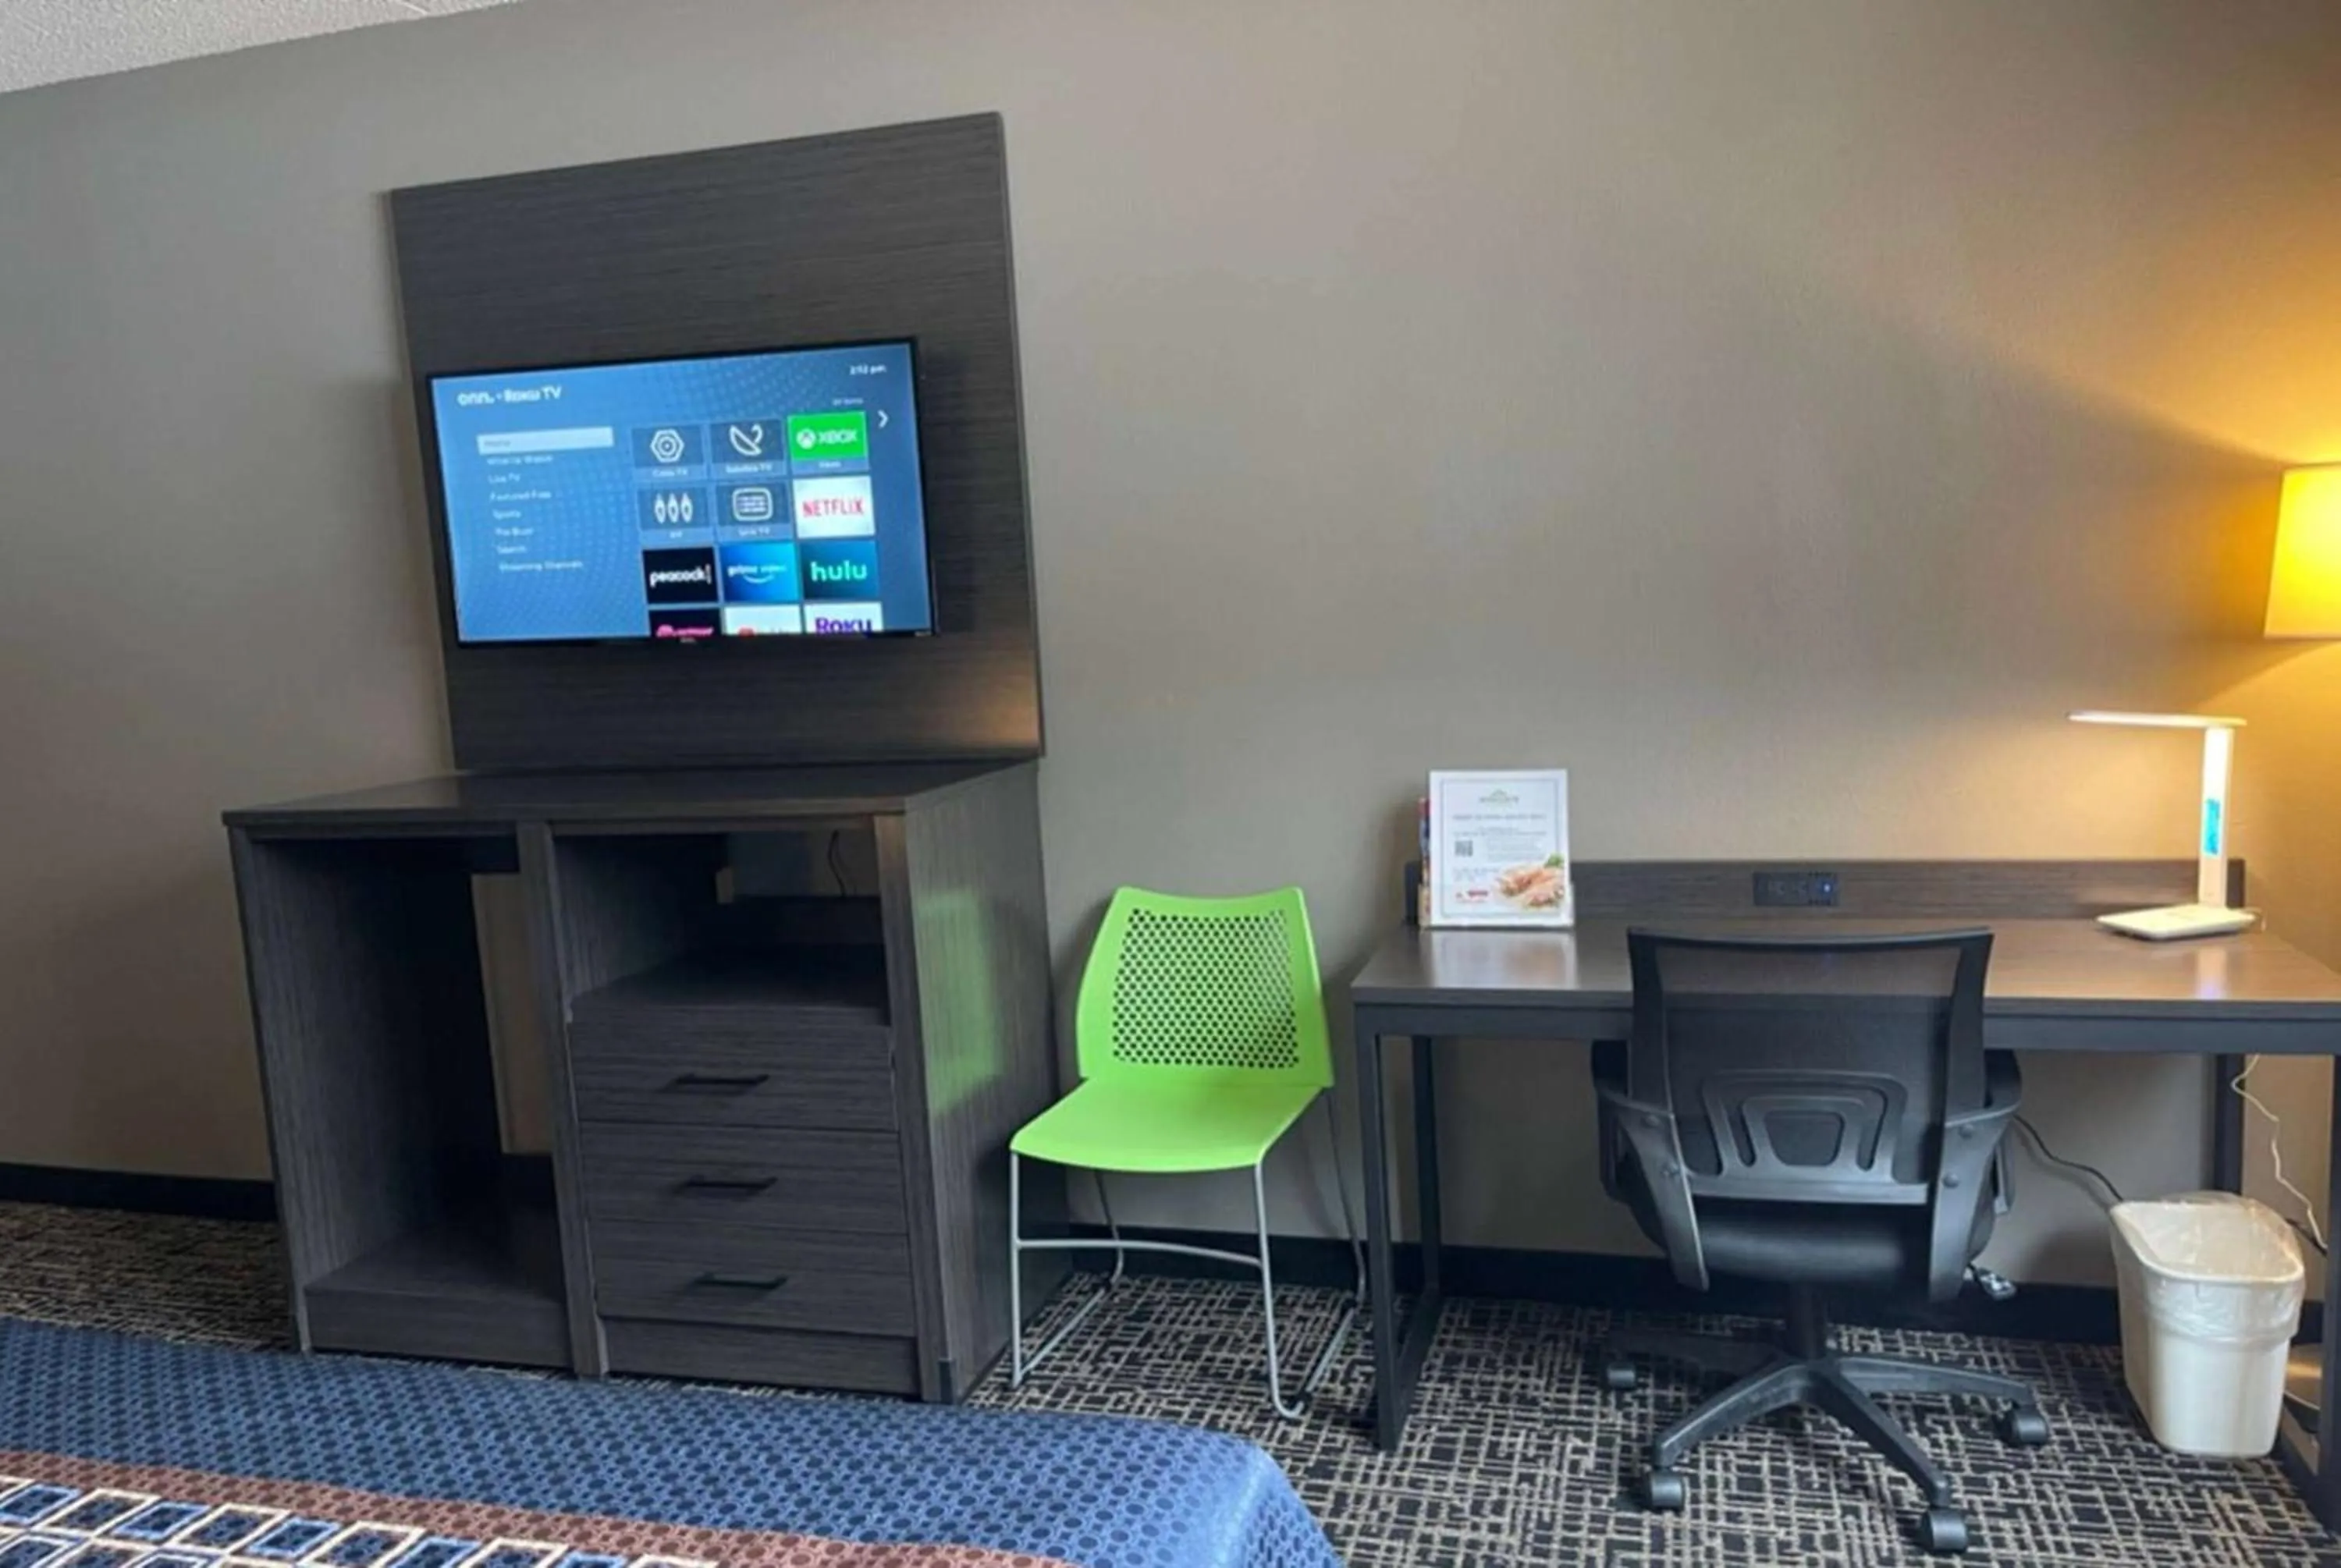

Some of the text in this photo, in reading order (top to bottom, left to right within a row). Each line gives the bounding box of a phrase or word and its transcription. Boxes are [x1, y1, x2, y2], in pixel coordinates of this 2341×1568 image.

[542, 385, 562, 399] TV
[819, 428, 858, 445] XBOX
[802, 497, 864, 517] NETFLIX
[810, 559, 867, 581] hulu
